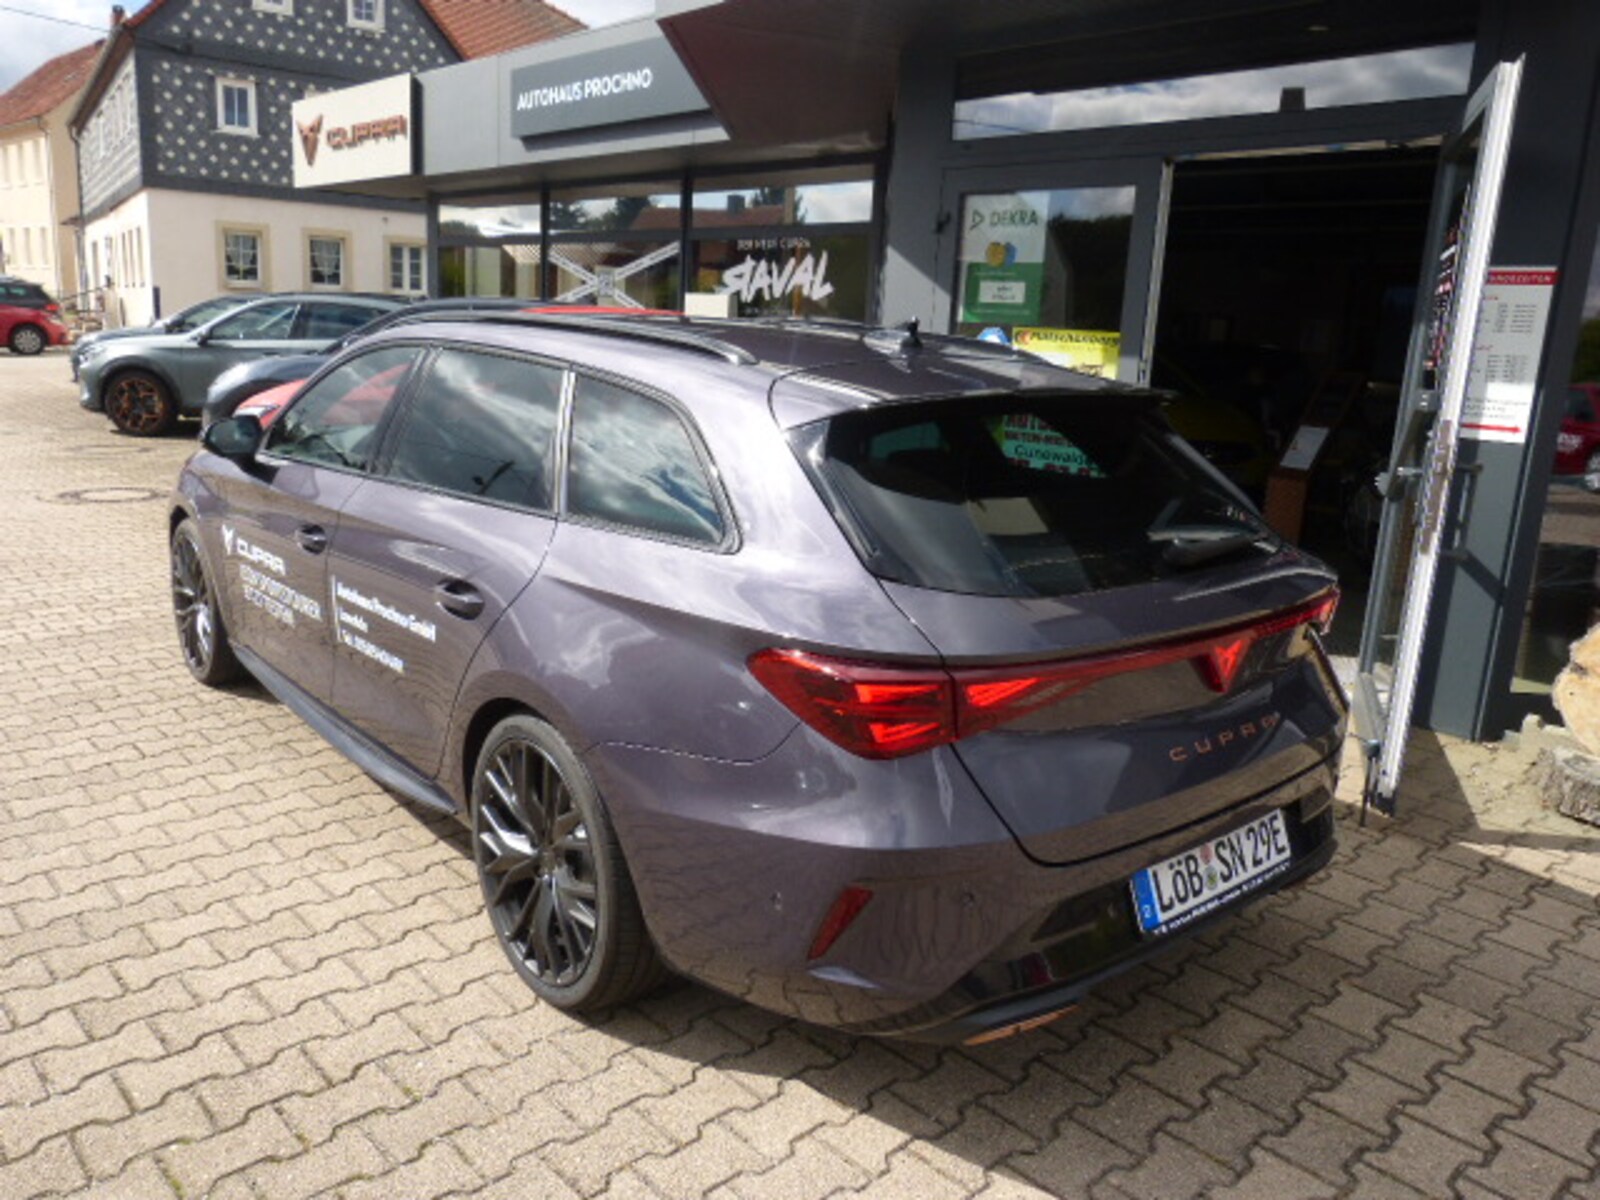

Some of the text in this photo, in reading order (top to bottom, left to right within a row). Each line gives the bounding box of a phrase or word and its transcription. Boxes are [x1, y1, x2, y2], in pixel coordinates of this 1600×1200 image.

[516, 66, 653, 111] AUTOHAUS PROCHNO
[326, 114, 407, 151] CUPRA
[989, 209, 1039, 226] DEKRA
[1152, 853, 1204, 914] LÖB
[1214, 837, 1248, 884] SN
[1246, 813, 1287, 868] 29E
